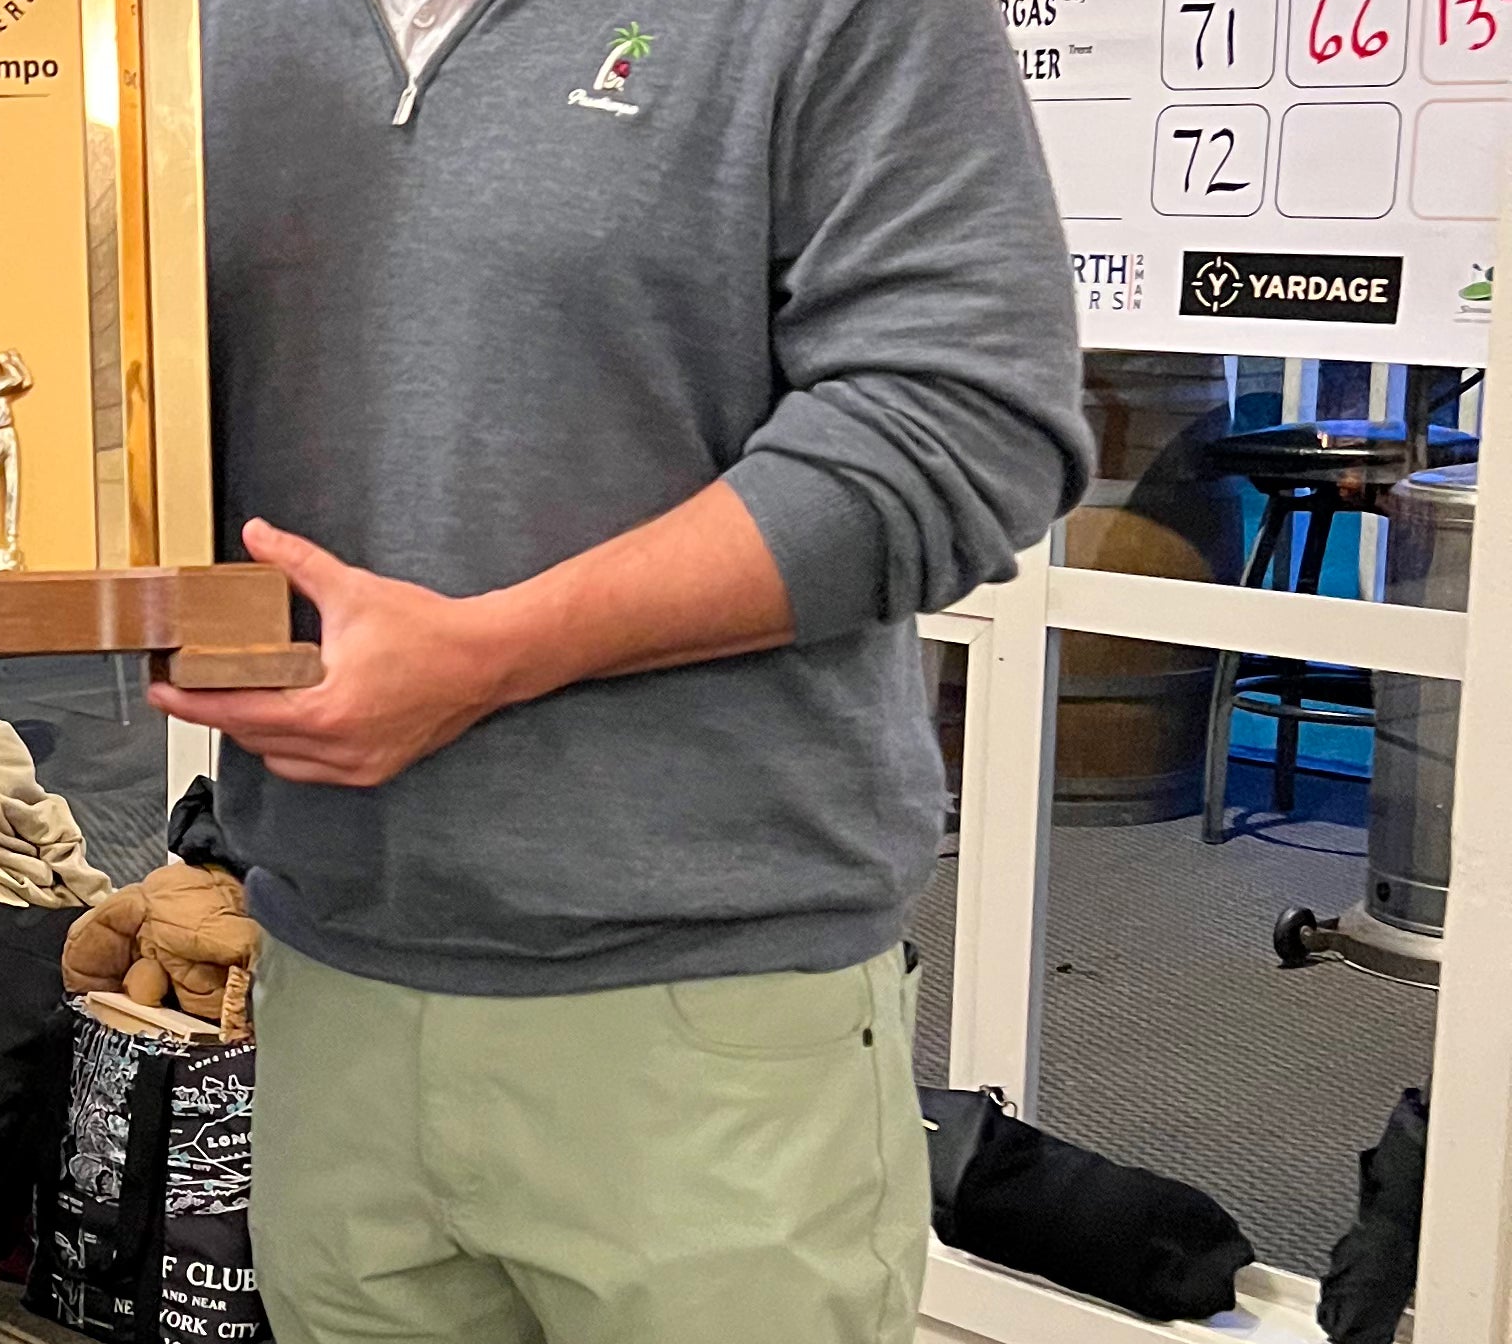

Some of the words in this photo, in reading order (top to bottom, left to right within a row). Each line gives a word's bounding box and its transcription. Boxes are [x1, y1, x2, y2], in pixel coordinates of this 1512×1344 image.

[1180, 3, 1236, 70] 71
[1173, 128, 1251, 196] 72
[1249, 273, 1389, 304] YARDAGE
[186, 1261, 258, 1293] CLUB
[114, 1297, 135, 1316] NE
[217, 1322, 261, 1340] CITY
[191, 1295, 227, 1312] NEAR
